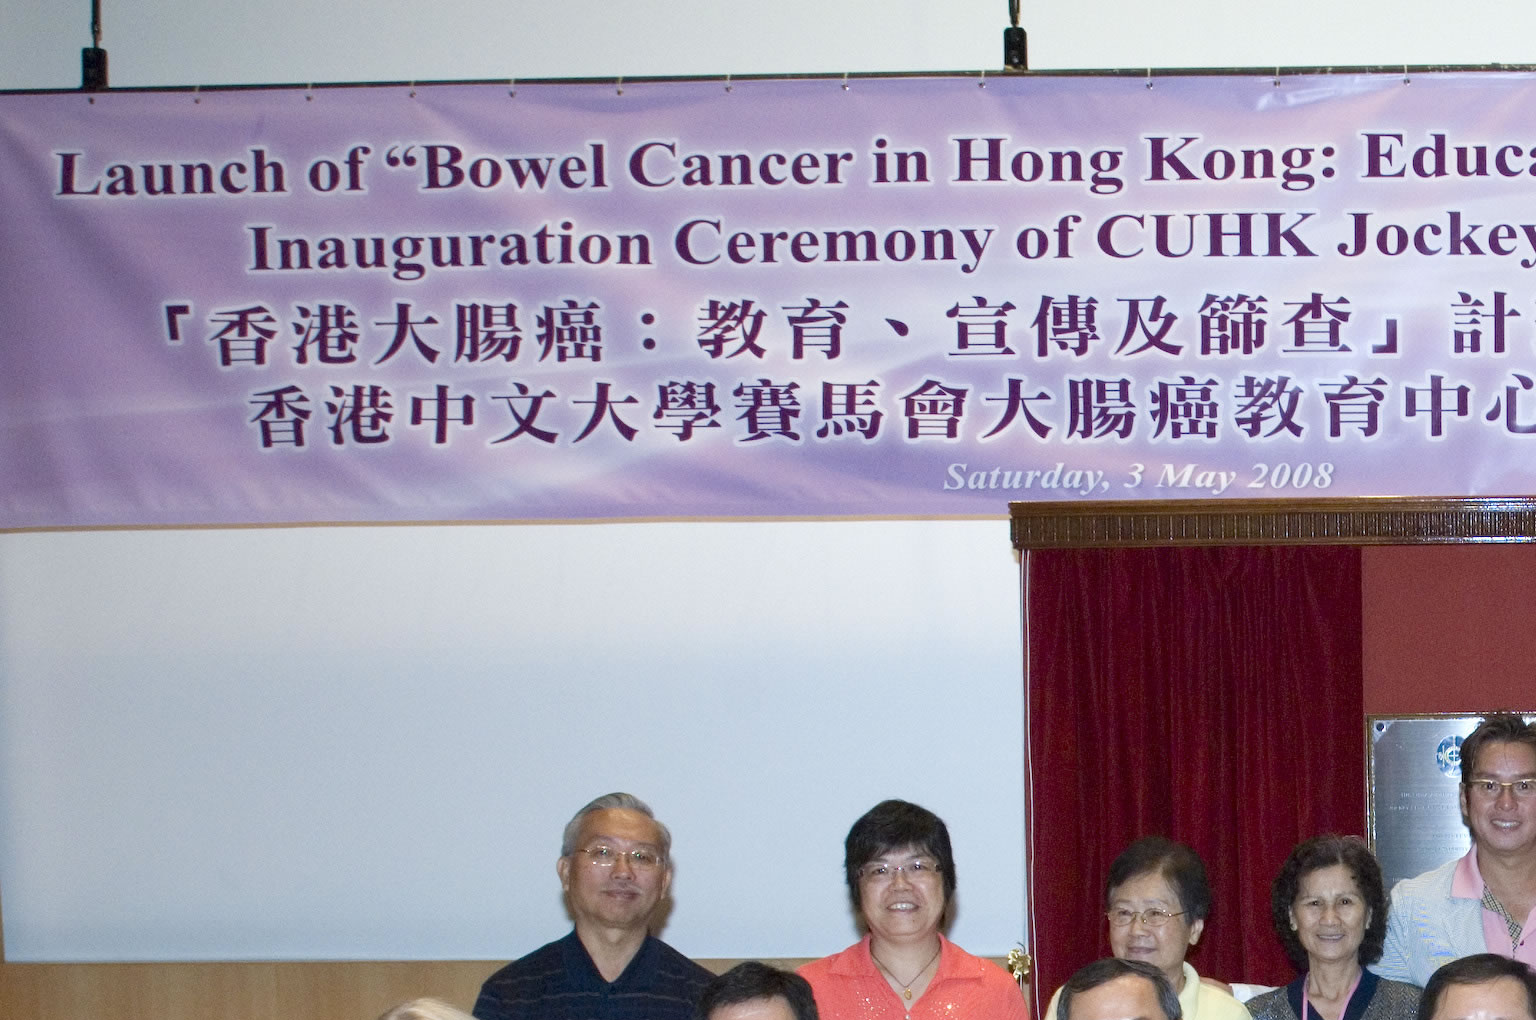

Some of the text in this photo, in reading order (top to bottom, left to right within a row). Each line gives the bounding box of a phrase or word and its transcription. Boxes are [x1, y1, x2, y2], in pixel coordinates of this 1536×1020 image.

[58, 149, 285, 196] Launch
[309, 146, 371, 192] of
[386, 144, 606, 189] “Bowel
[629, 142, 853, 187] Cancer
[874, 138, 929, 183] in
[955, 138, 1124, 195] Hong
[1146, 137, 1335, 192] Kong:
[250, 221, 651, 281] Inauguration
[675, 219, 993, 274] Ceremony
[1017, 216, 1081, 259] of
[1097, 212, 1318, 259] CUHK
[944, 461, 1334, 496] Saturday, 3 May 2008
